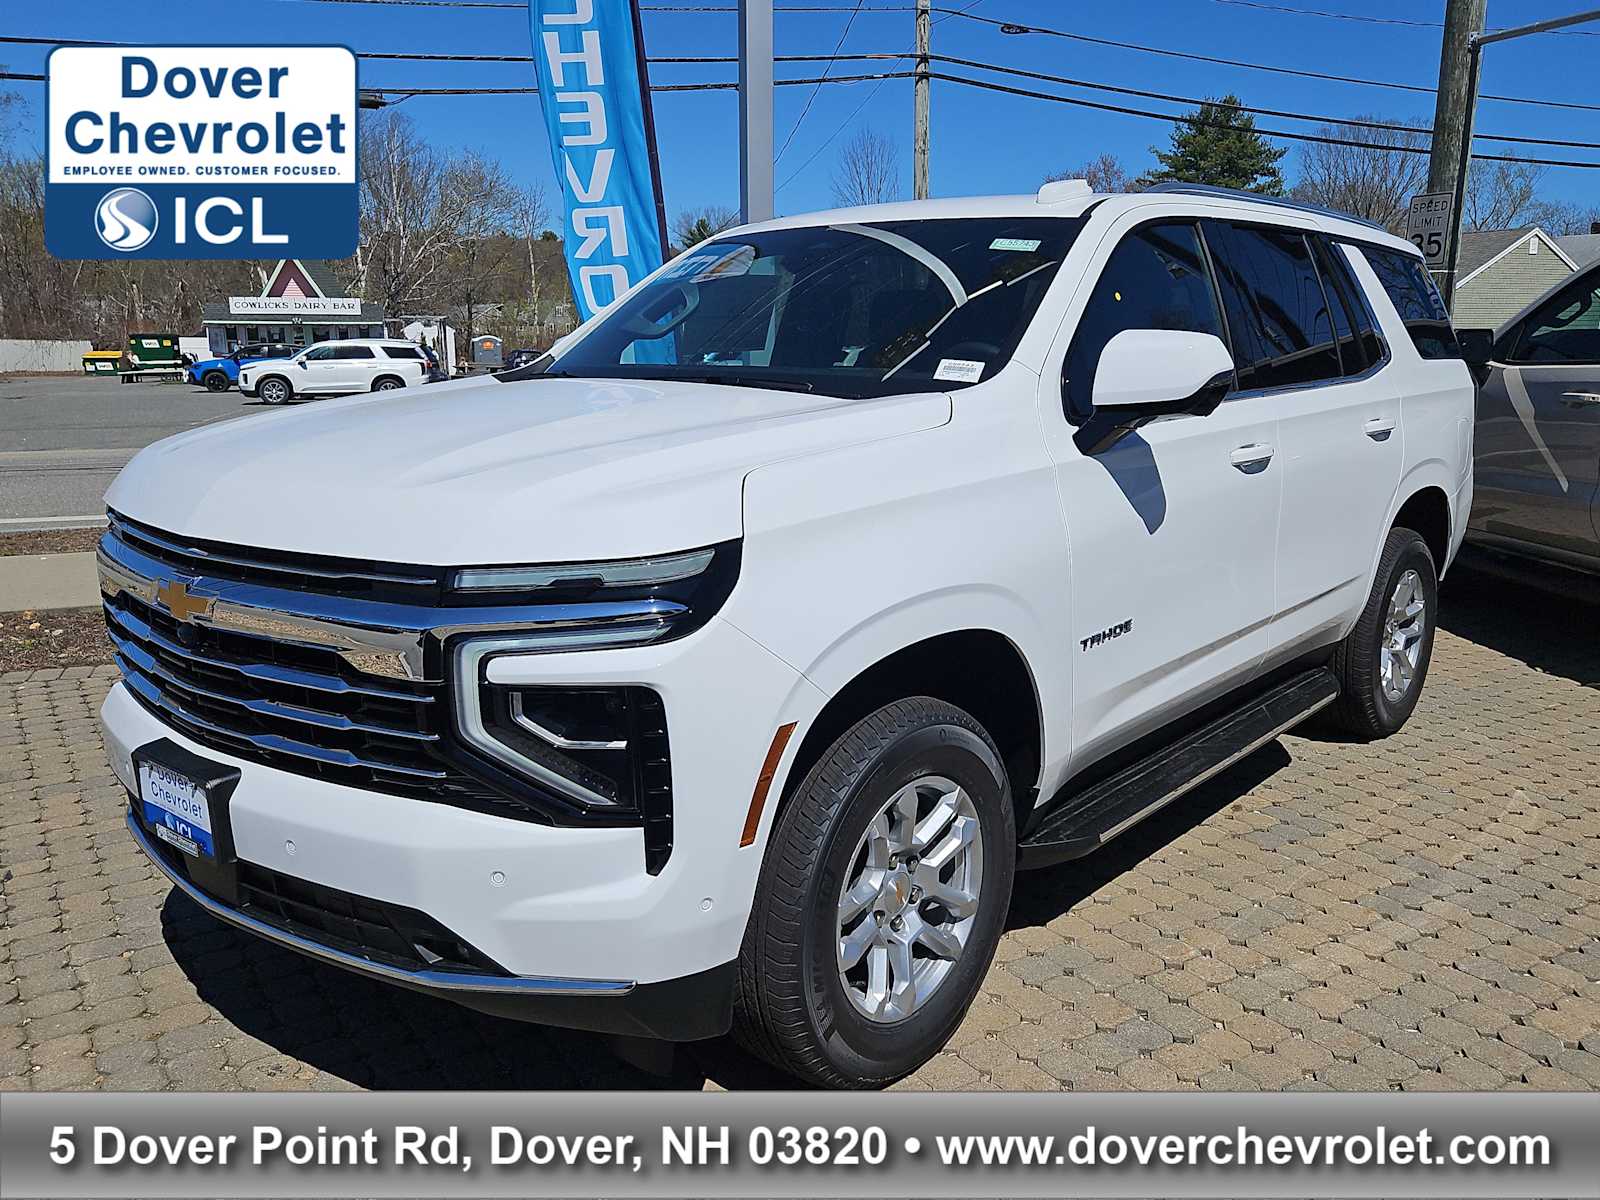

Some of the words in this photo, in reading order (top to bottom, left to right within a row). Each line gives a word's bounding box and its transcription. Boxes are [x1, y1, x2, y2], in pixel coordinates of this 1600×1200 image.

[1412, 200, 1448, 214] SPEED
[1414, 216, 1442, 228] LIMIT
[234, 301, 289, 309] COWLICKS
[294, 302, 327, 310] DAIRY
[1080, 619, 1132, 652] TAHOE
[151, 781, 202, 819] Chevrolet
